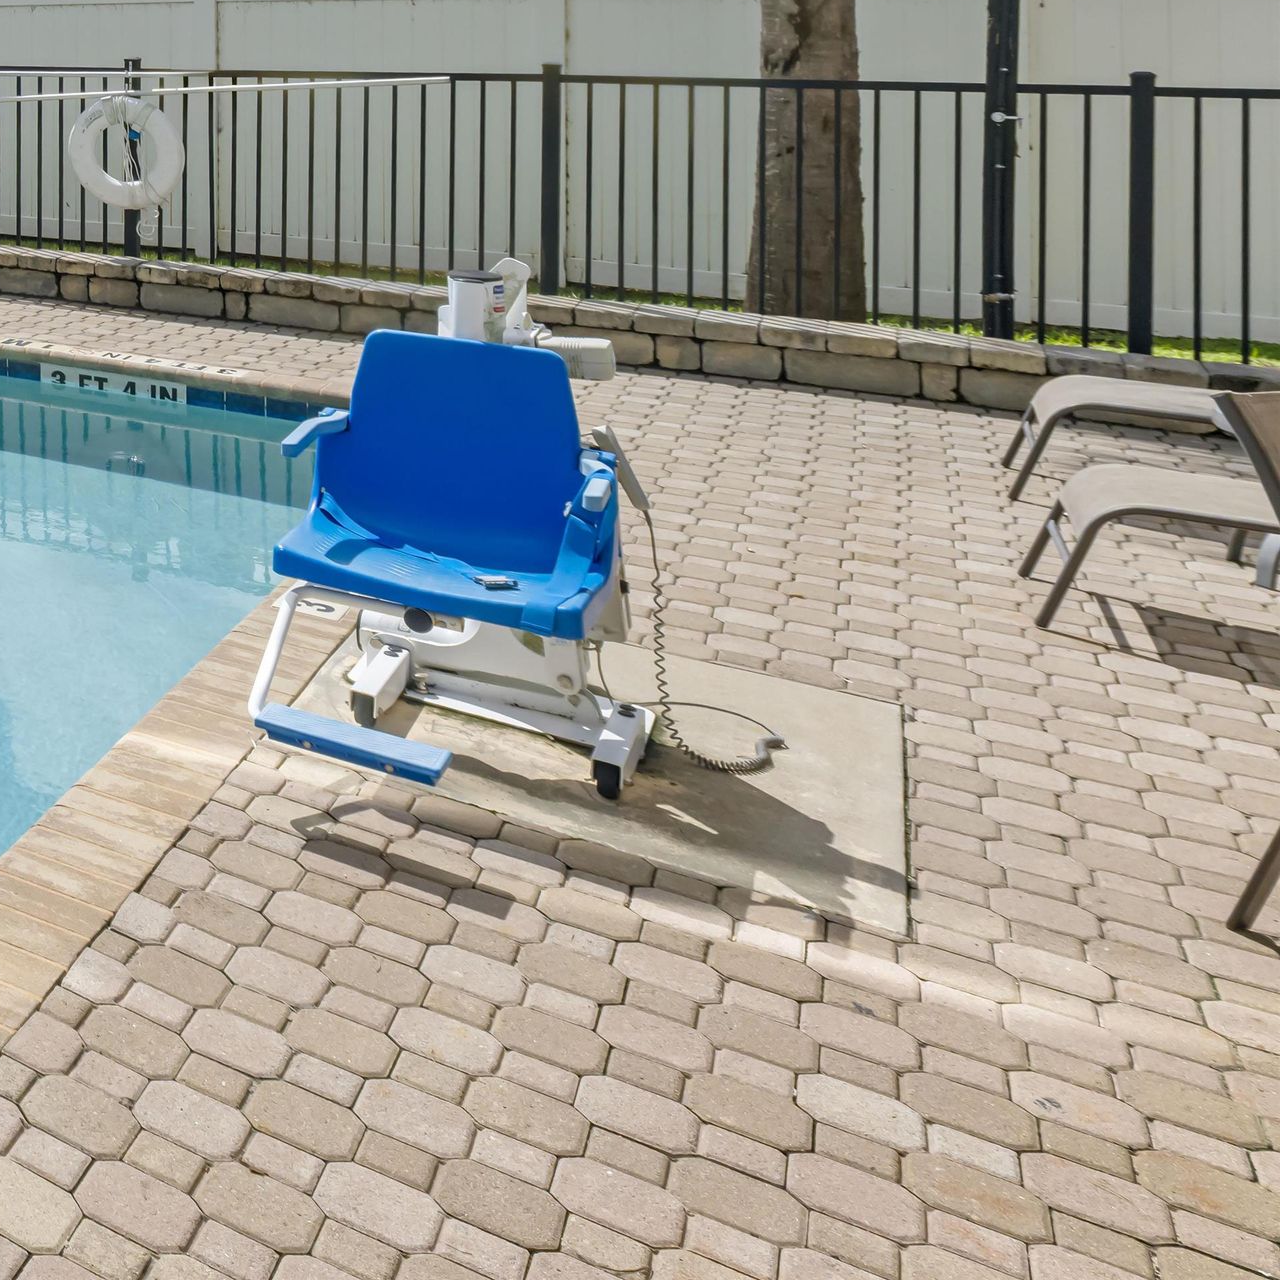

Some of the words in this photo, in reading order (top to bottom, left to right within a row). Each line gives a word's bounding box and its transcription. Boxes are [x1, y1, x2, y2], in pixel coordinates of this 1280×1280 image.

[50, 370, 67, 386] 3
[78, 373, 109, 391] FT
[122, 380, 137, 396] 4
